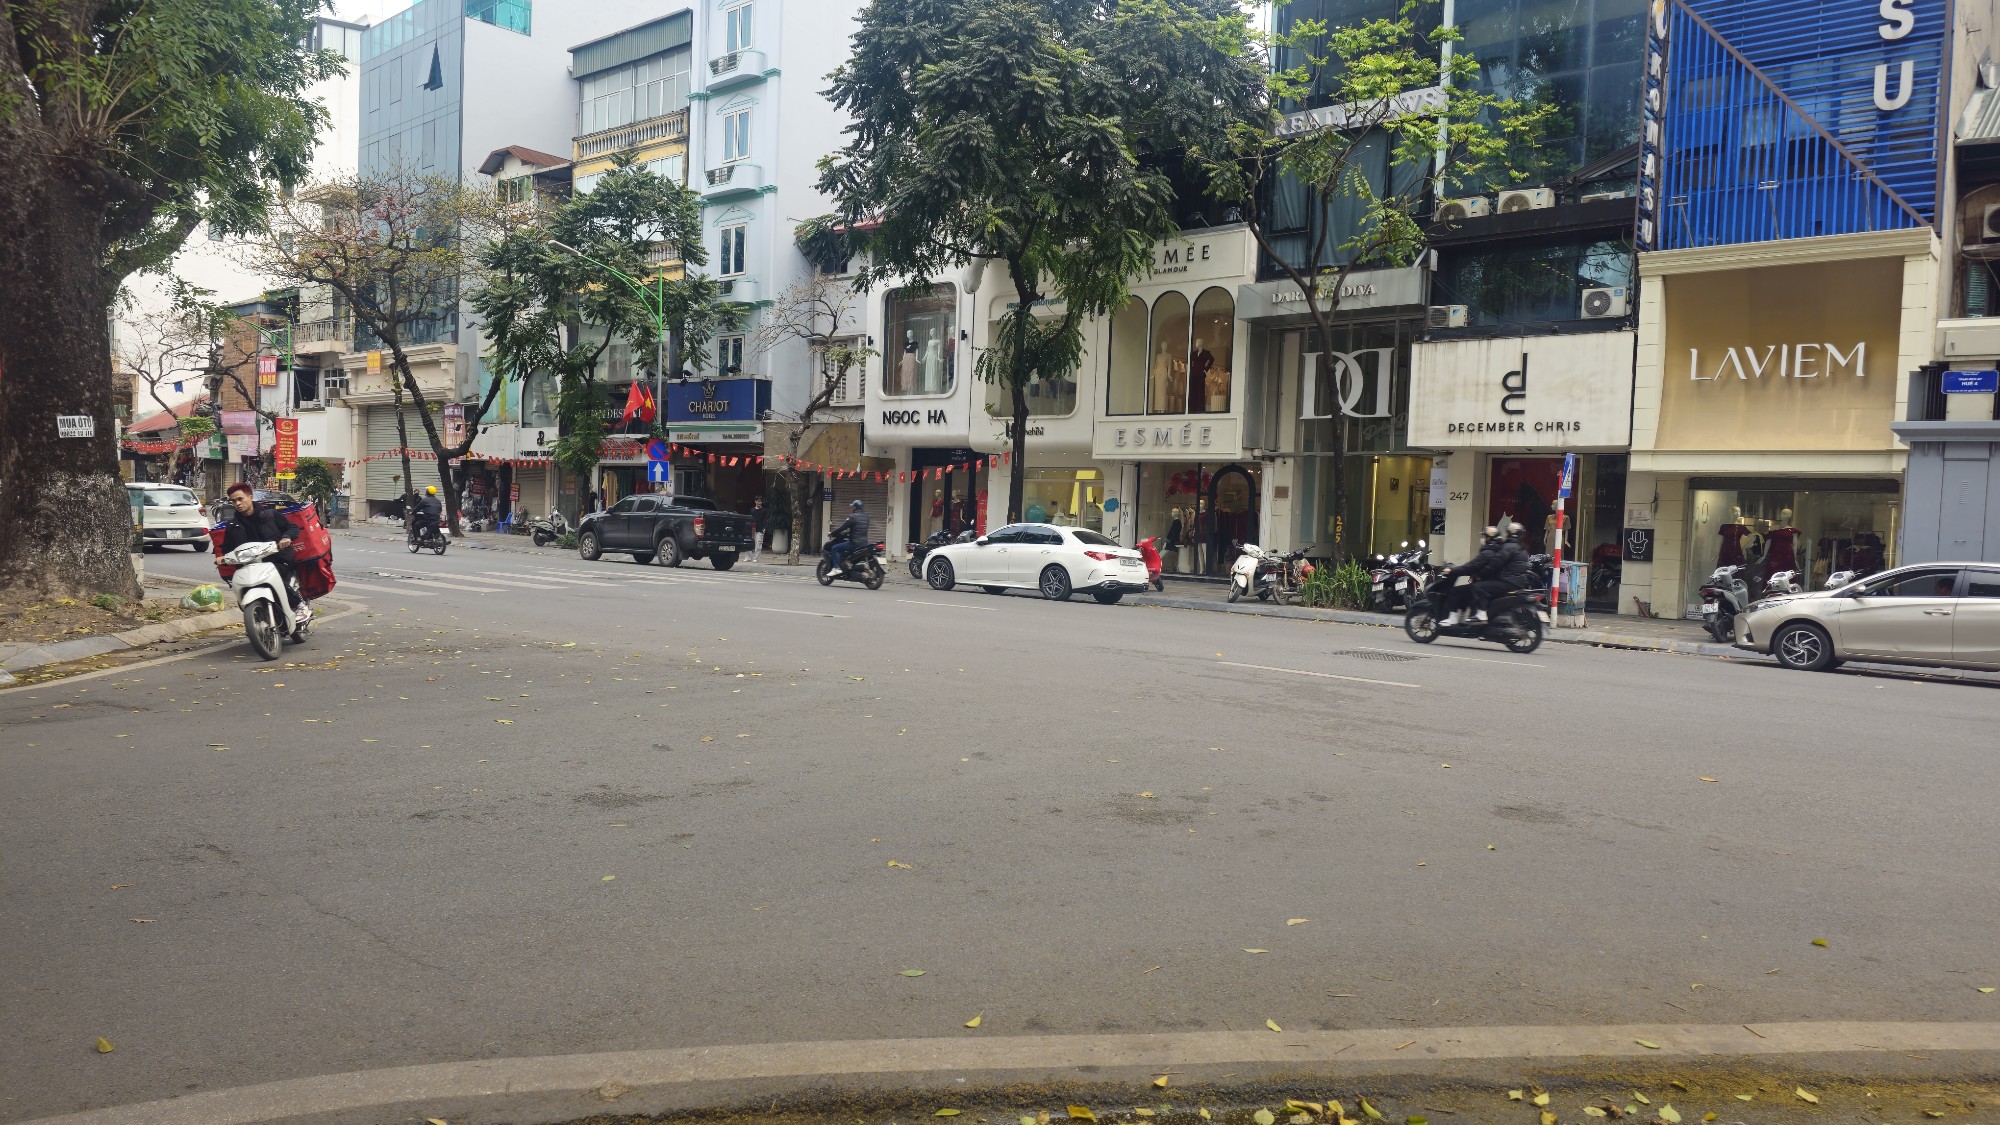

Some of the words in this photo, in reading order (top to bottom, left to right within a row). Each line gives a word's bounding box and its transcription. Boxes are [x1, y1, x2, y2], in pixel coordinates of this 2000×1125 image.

[1154, 266, 1188, 275] GLAMOUR
[1342, 285, 1375, 297] DIVA
[1690, 342, 1866, 380] LAVIEM
[688, 401, 728, 412] CHARIOT
[59, 418, 77, 428] MUA
[882, 410, 920, 425] NGOC
[1448, 422, 1525, 433] DECEMBER
[1534, 421, 1581, 432] CHRIS
[1115, 422, 1213, 446] ESMÉE
[1450, 491, 1469, 501] 247
